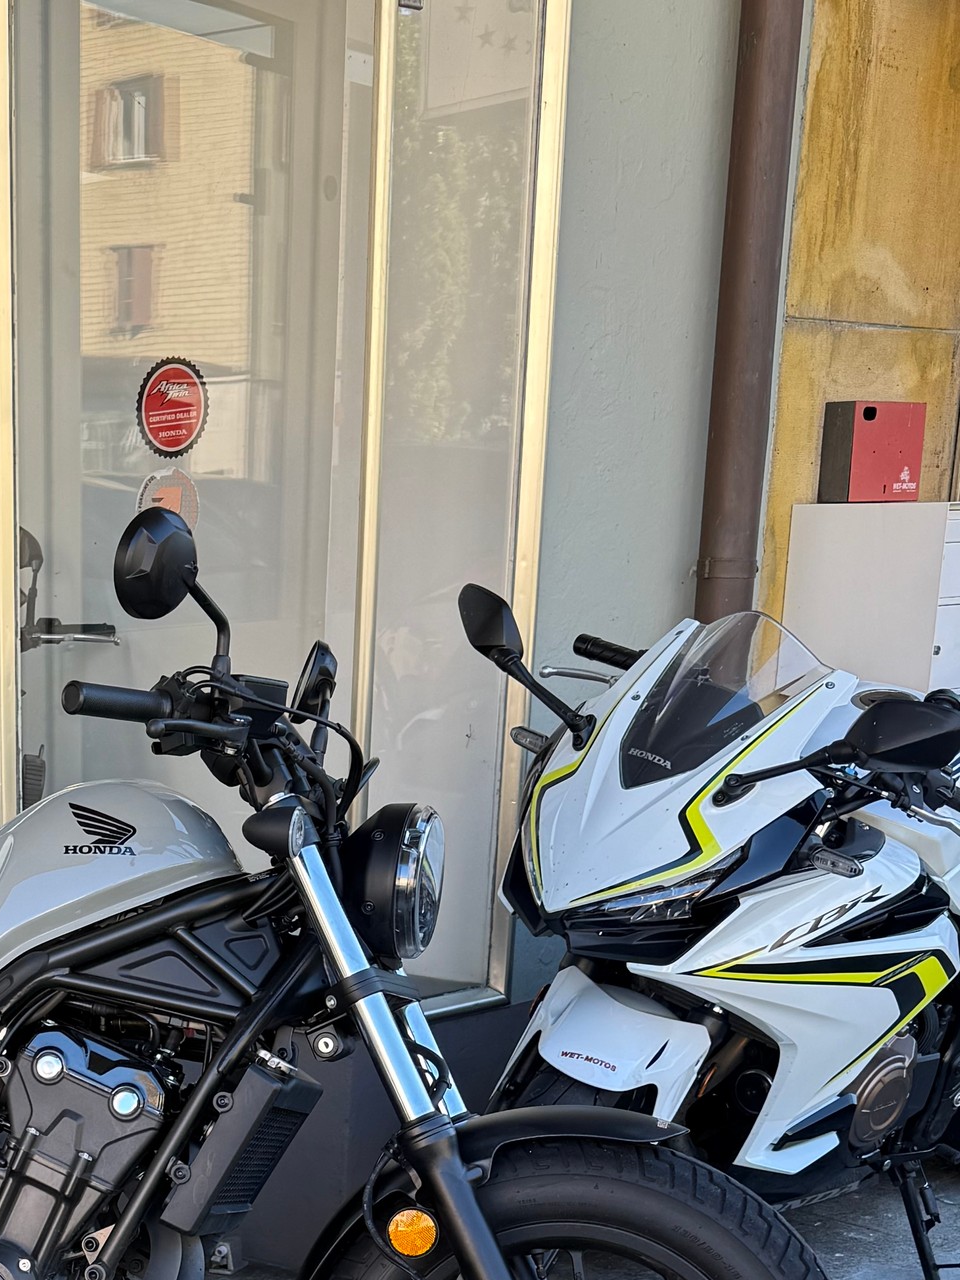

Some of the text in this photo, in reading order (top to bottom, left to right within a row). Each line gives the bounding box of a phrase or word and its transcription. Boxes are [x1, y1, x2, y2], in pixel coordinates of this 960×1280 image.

[150, 380, 189, 396] Africa
[163, 390, 192, 404] Twin
[149, 411, 197, 423] CERTIFIED DEALER
[159, 429, 187, 437] HONDA
[627, 747, 672, 770] HONDA
[63, 845, 137, 856] HONDA
[768, 884, 891, 952] CBR
[560, 1050, 617, 1072] WET-MOTOS
